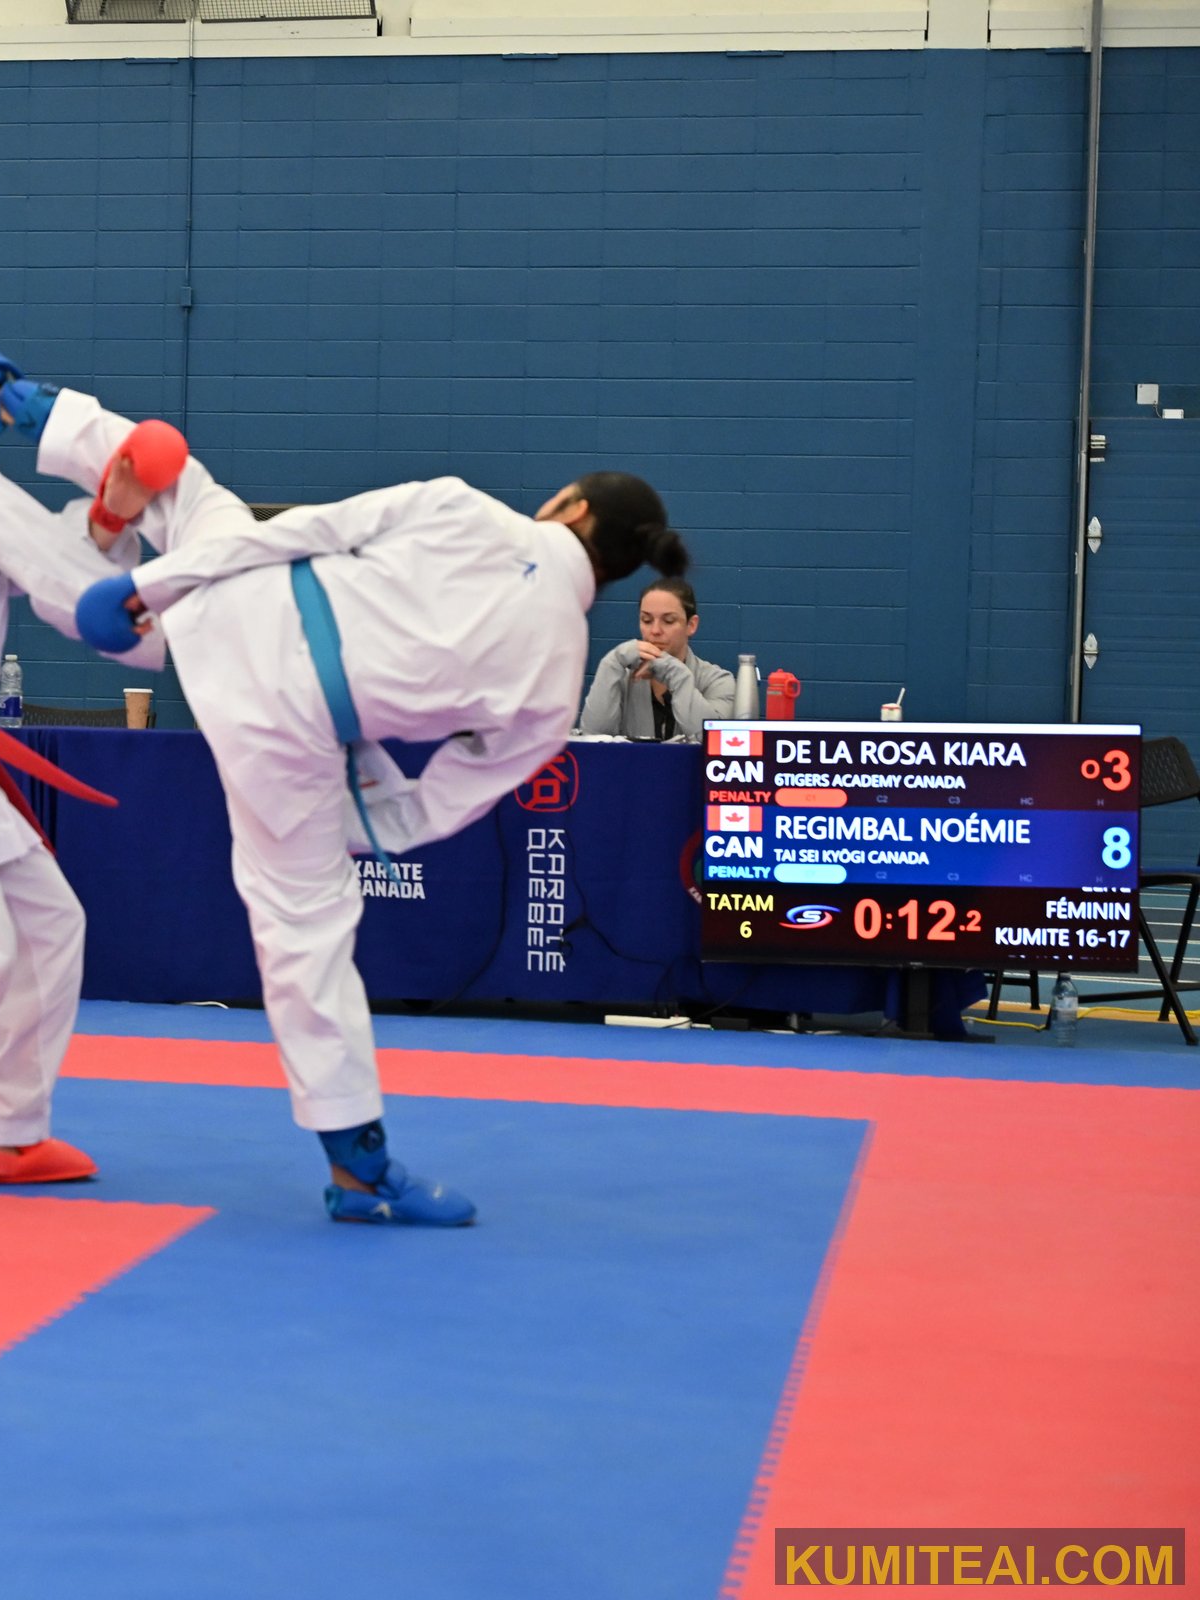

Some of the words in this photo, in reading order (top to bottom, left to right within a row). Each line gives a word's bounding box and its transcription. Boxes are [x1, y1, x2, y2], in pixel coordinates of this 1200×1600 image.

[776, 739, 811, 764] DE
[819, 740, 853, 765] LA
[860, 740, 936, 766] ROSA
[943, 741, 1027, 767] KIARA
[705, 760, 764, 783] CAN
[774, 773, 830, 787] 6TIGERS
[832, 774, 902, 788] ACADEMY
[903, 774, 966, 789] CANADA
[709, 790, 772, 803] PENALTY
[775, 815, 913, 841] REGIMBAL
[920, 812, 1031, 844] NOÉMIE
[705, 835, 763, 858] CAN
[774, 849, 796, 862] TAI
[799, 849, 819, 863] SEI
[868, 850, 929, 865] CANADA
[1101, 826, 1132, 869] 8
[708, 865, 771, 879] PENALTY
[360, 879, 426, 899] ANADA
[706, 893, 774, 912] TATAM
[1046, 897, 1131, 921] FÉMININ
[739, 921, 752, 939] 6
[995, 926, 1070, 947] KUMITE
[1075, 929, 1131, 948] 16-17
